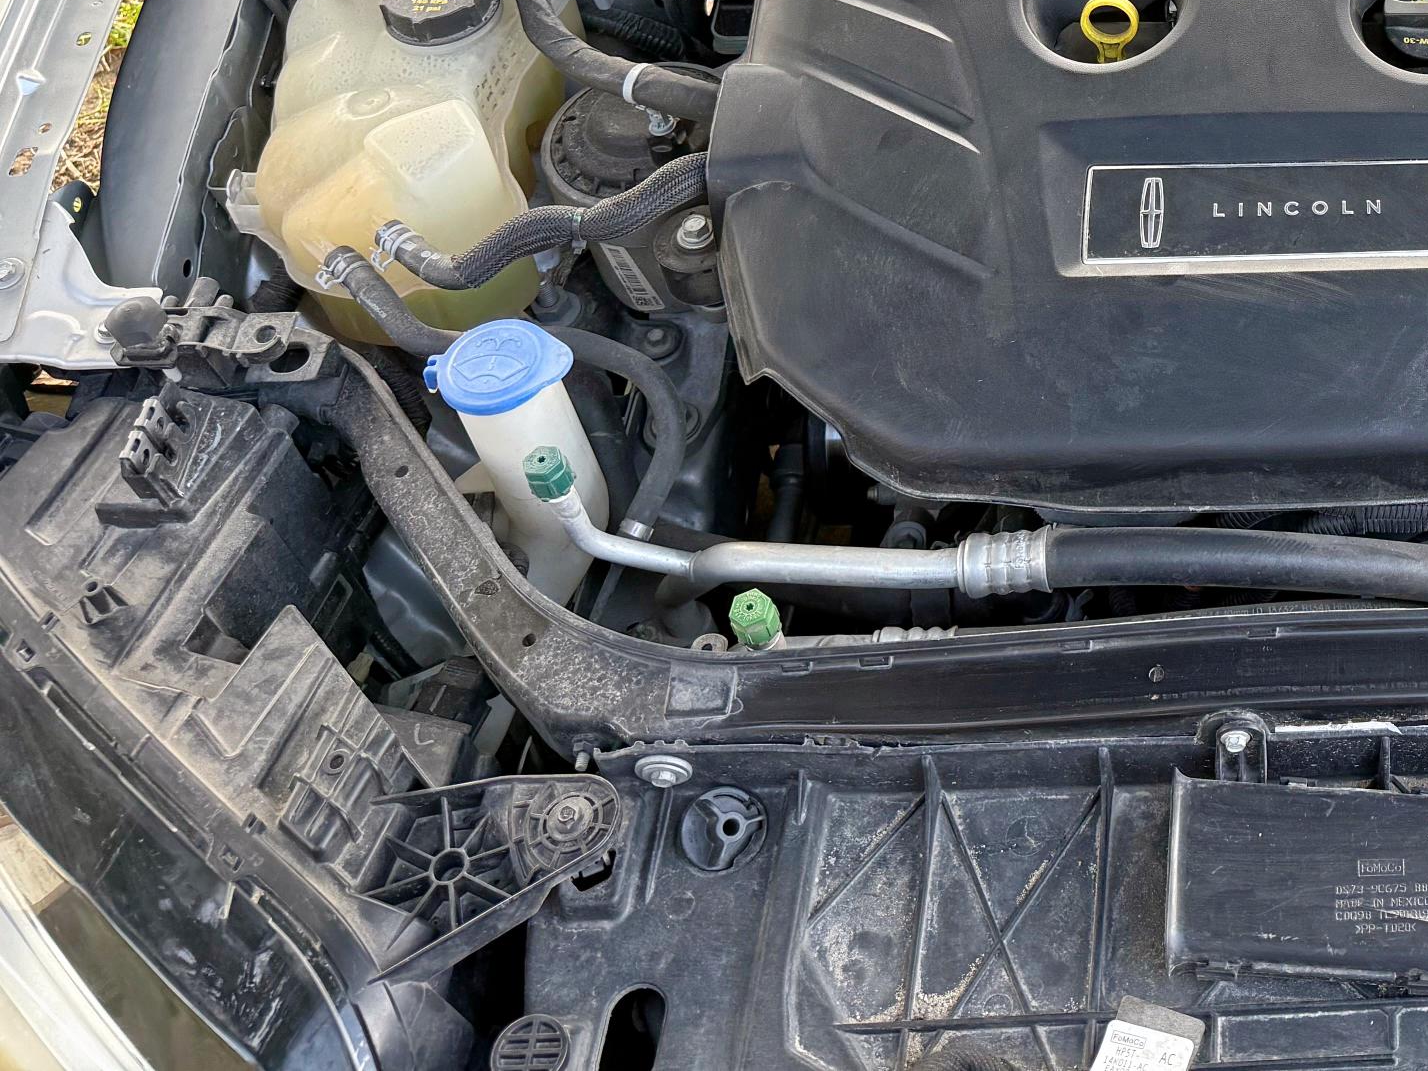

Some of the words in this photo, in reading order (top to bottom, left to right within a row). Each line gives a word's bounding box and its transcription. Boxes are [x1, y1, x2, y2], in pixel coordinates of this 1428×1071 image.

[1212, 198, 1383, 219] LINCOLN
[1361, 860, 1402, 874] FoMoCo
[1336, 898, 1363, 909] MADE
[1372, 897, 1384, 908] IN
[1112, 1033, 1145, 1047] FoMoCo
[1158, 1051, 1177, 1066] AC
